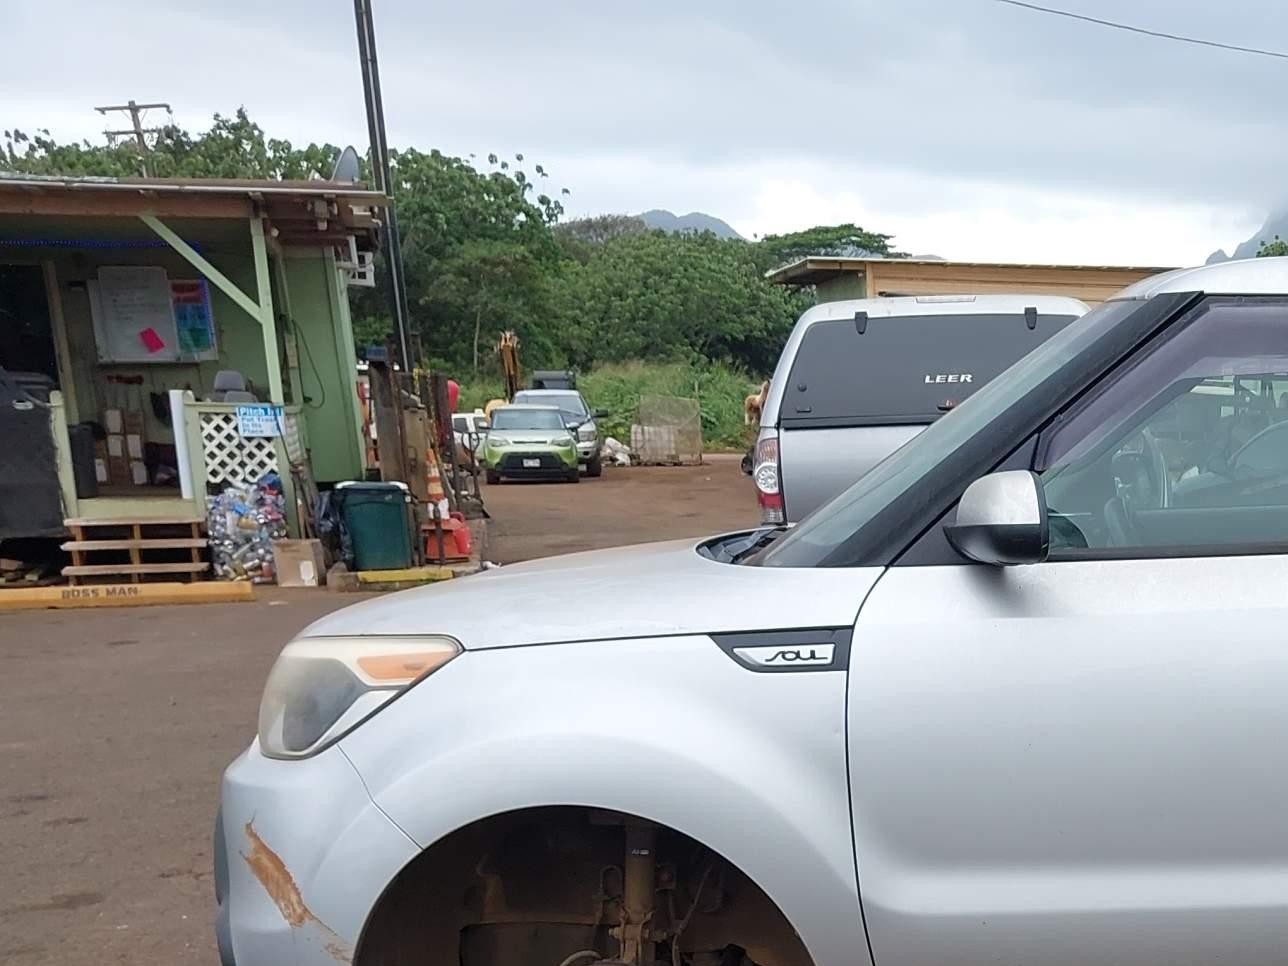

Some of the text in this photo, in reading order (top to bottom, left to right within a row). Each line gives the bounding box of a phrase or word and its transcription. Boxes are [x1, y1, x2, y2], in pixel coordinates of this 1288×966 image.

[924, 374, 973, 384] LEER
[239, 406, 266, 417] Pitch
[105, 586, 138, 597] MAN
